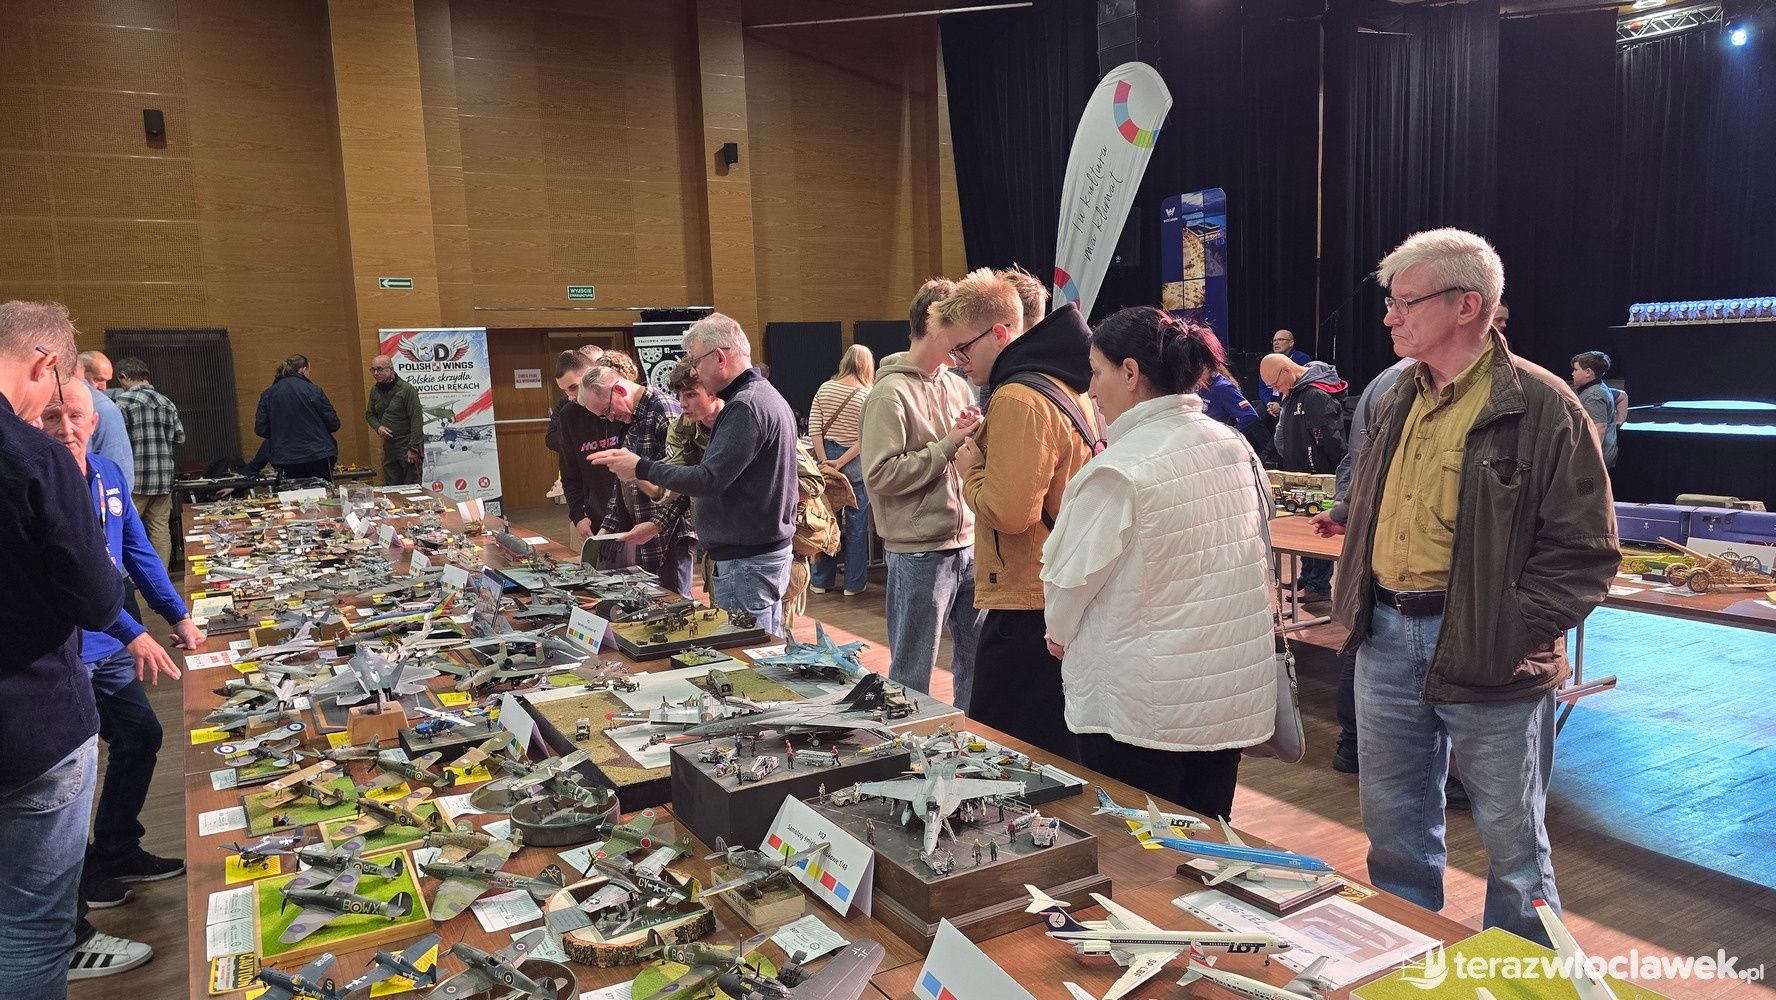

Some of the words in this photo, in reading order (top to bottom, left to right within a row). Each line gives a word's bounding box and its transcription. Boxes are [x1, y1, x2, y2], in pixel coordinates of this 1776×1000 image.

[1080, 144, 1107, 208] kultura
[1084, 234, 1097, 262] ma
[1092, 170, 1123, 233] klimat
[419, 343, 450, 362] 3D
[398, 363, 431, 371] POLISH
[443, 361, 474, 370] WINGS
[406, 375, 435, 385] Polskie
[437, 372, 472, 383] skrzydła
[415, 384, 445, 392] WOICH
[447, 382, 480, 392] RĘKACH
[580, 436, 619, 451] HORIZ
[1170, 819, 1194, 828] LOT
[1227, 942, 1262, 953] LOT
[238, 953, 254, 988] CAUTION
